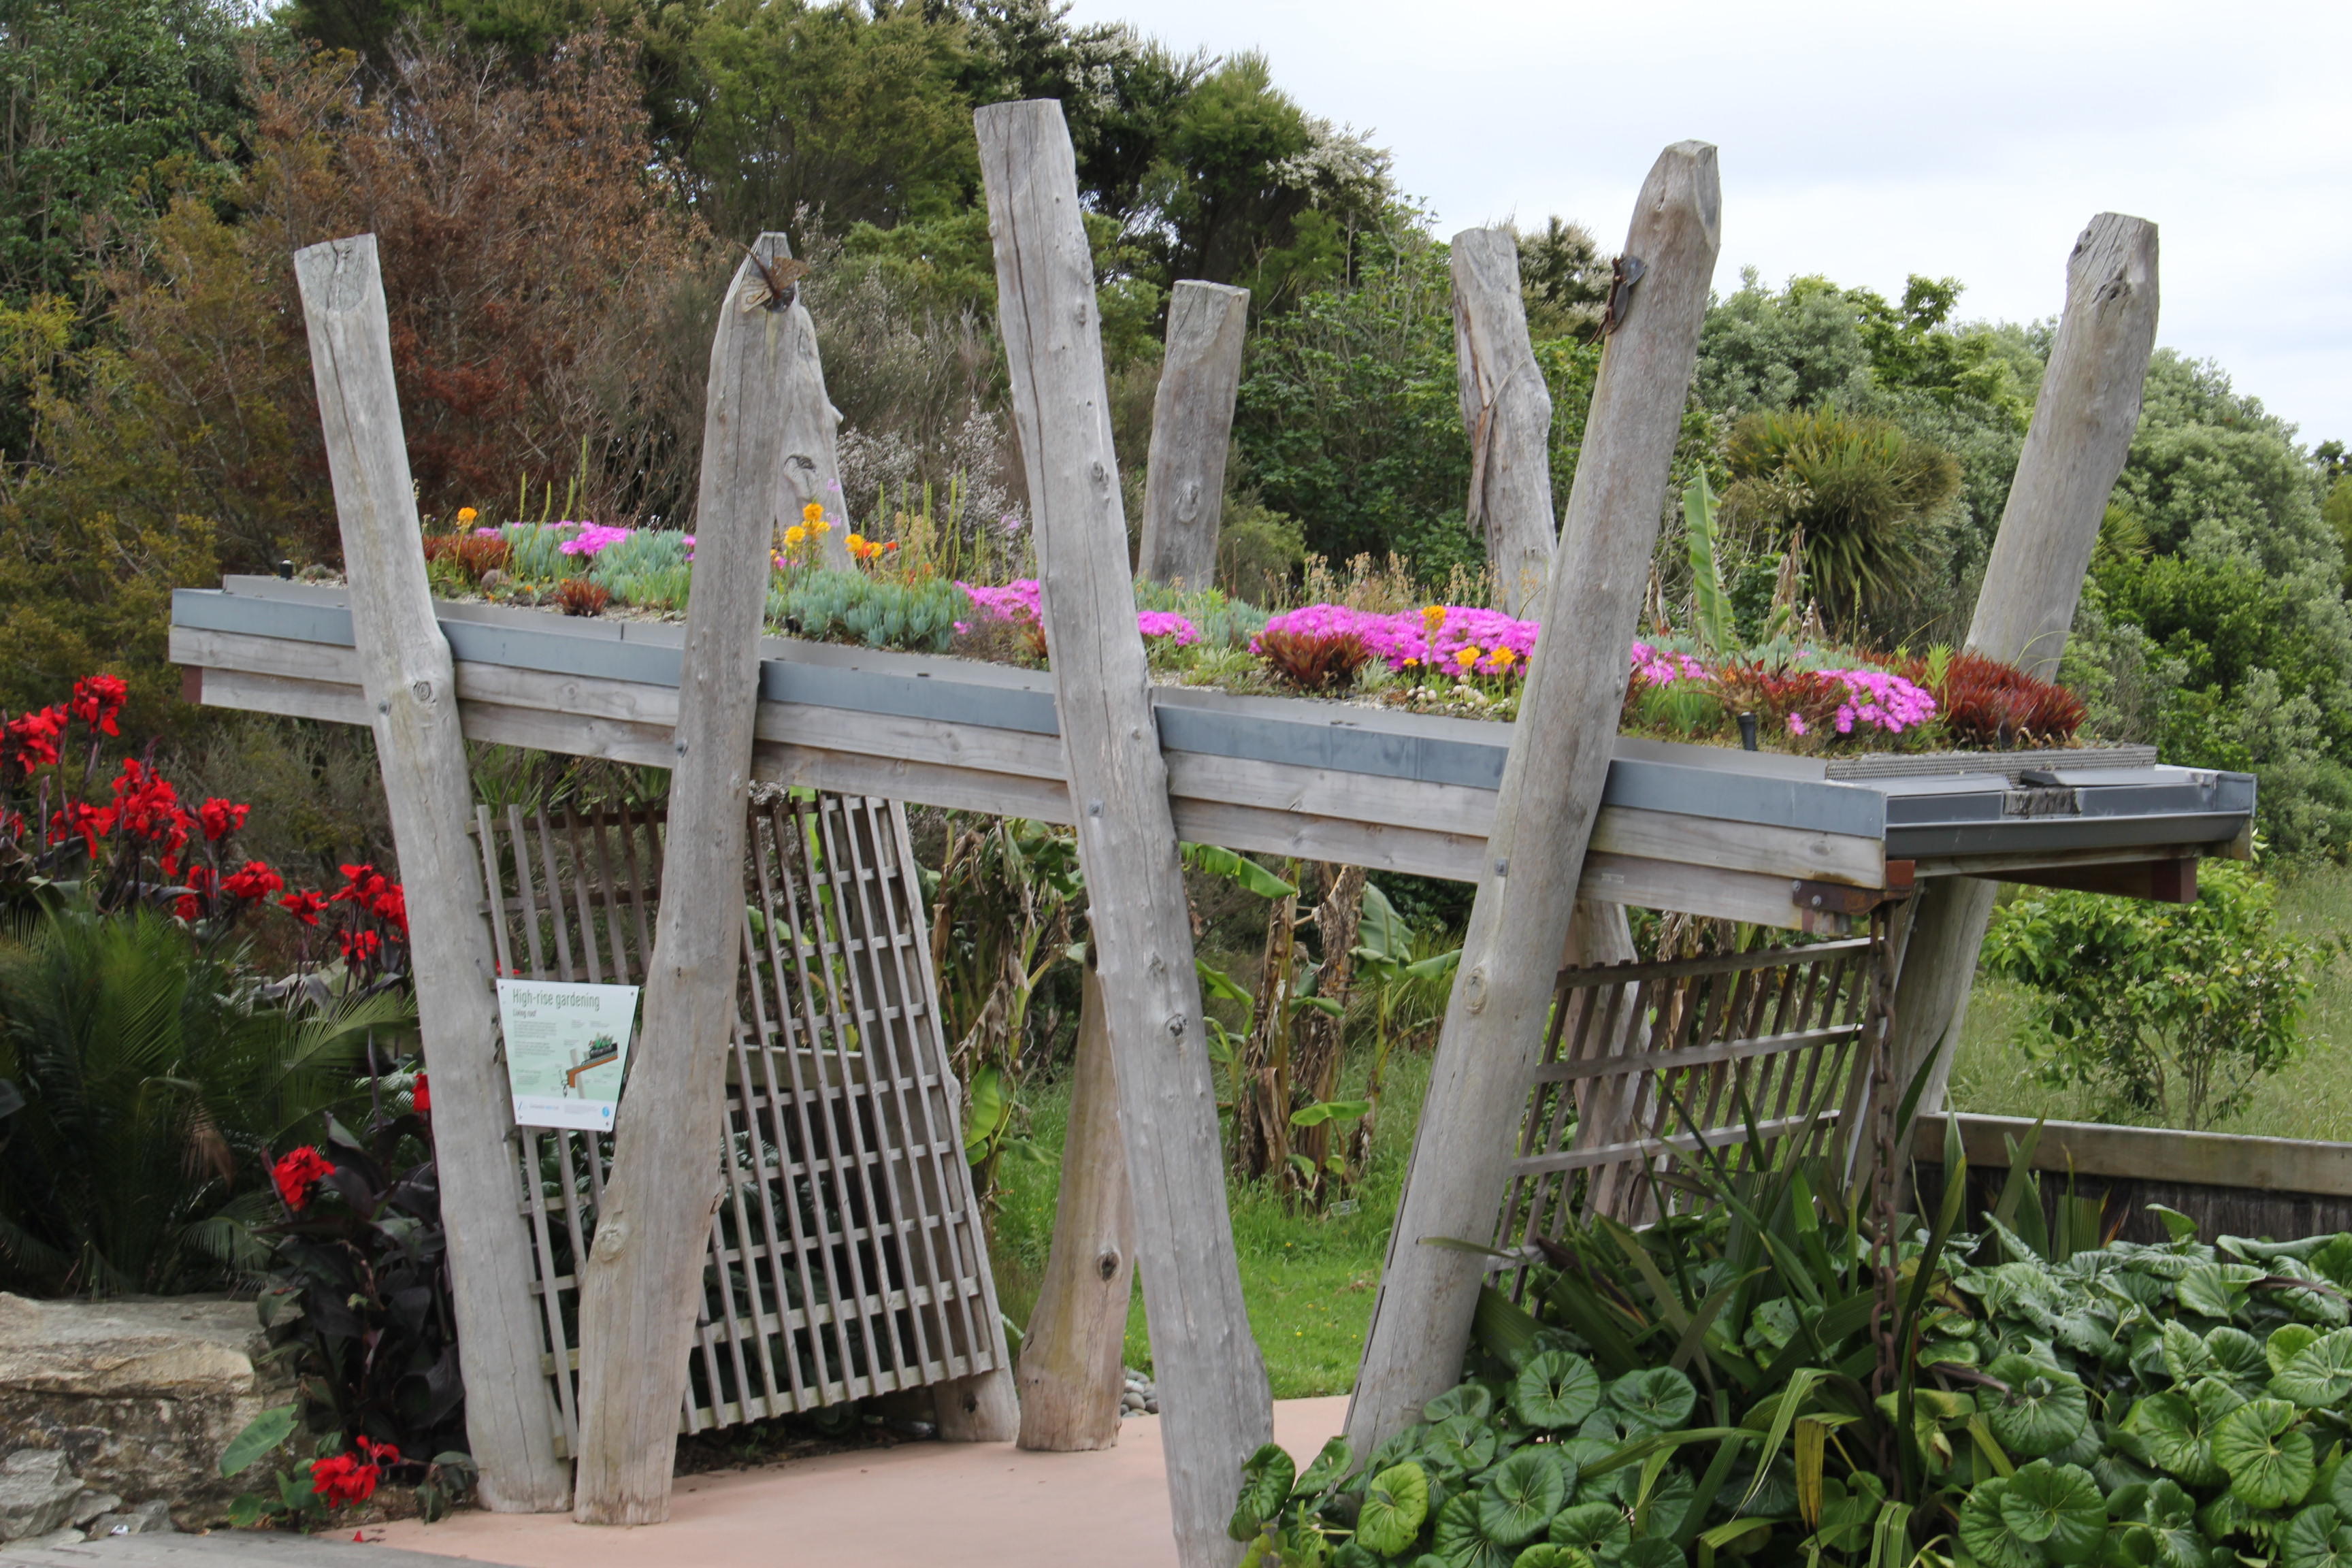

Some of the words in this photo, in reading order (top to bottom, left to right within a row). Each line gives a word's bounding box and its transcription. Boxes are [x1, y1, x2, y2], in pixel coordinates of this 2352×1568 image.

[512, 988, 553, 1007] High-rise
[555, 991, 600, 1011] gardening
[512, 1009, 526, 1018] Living
[527, 1009, 536, 1017] roof
